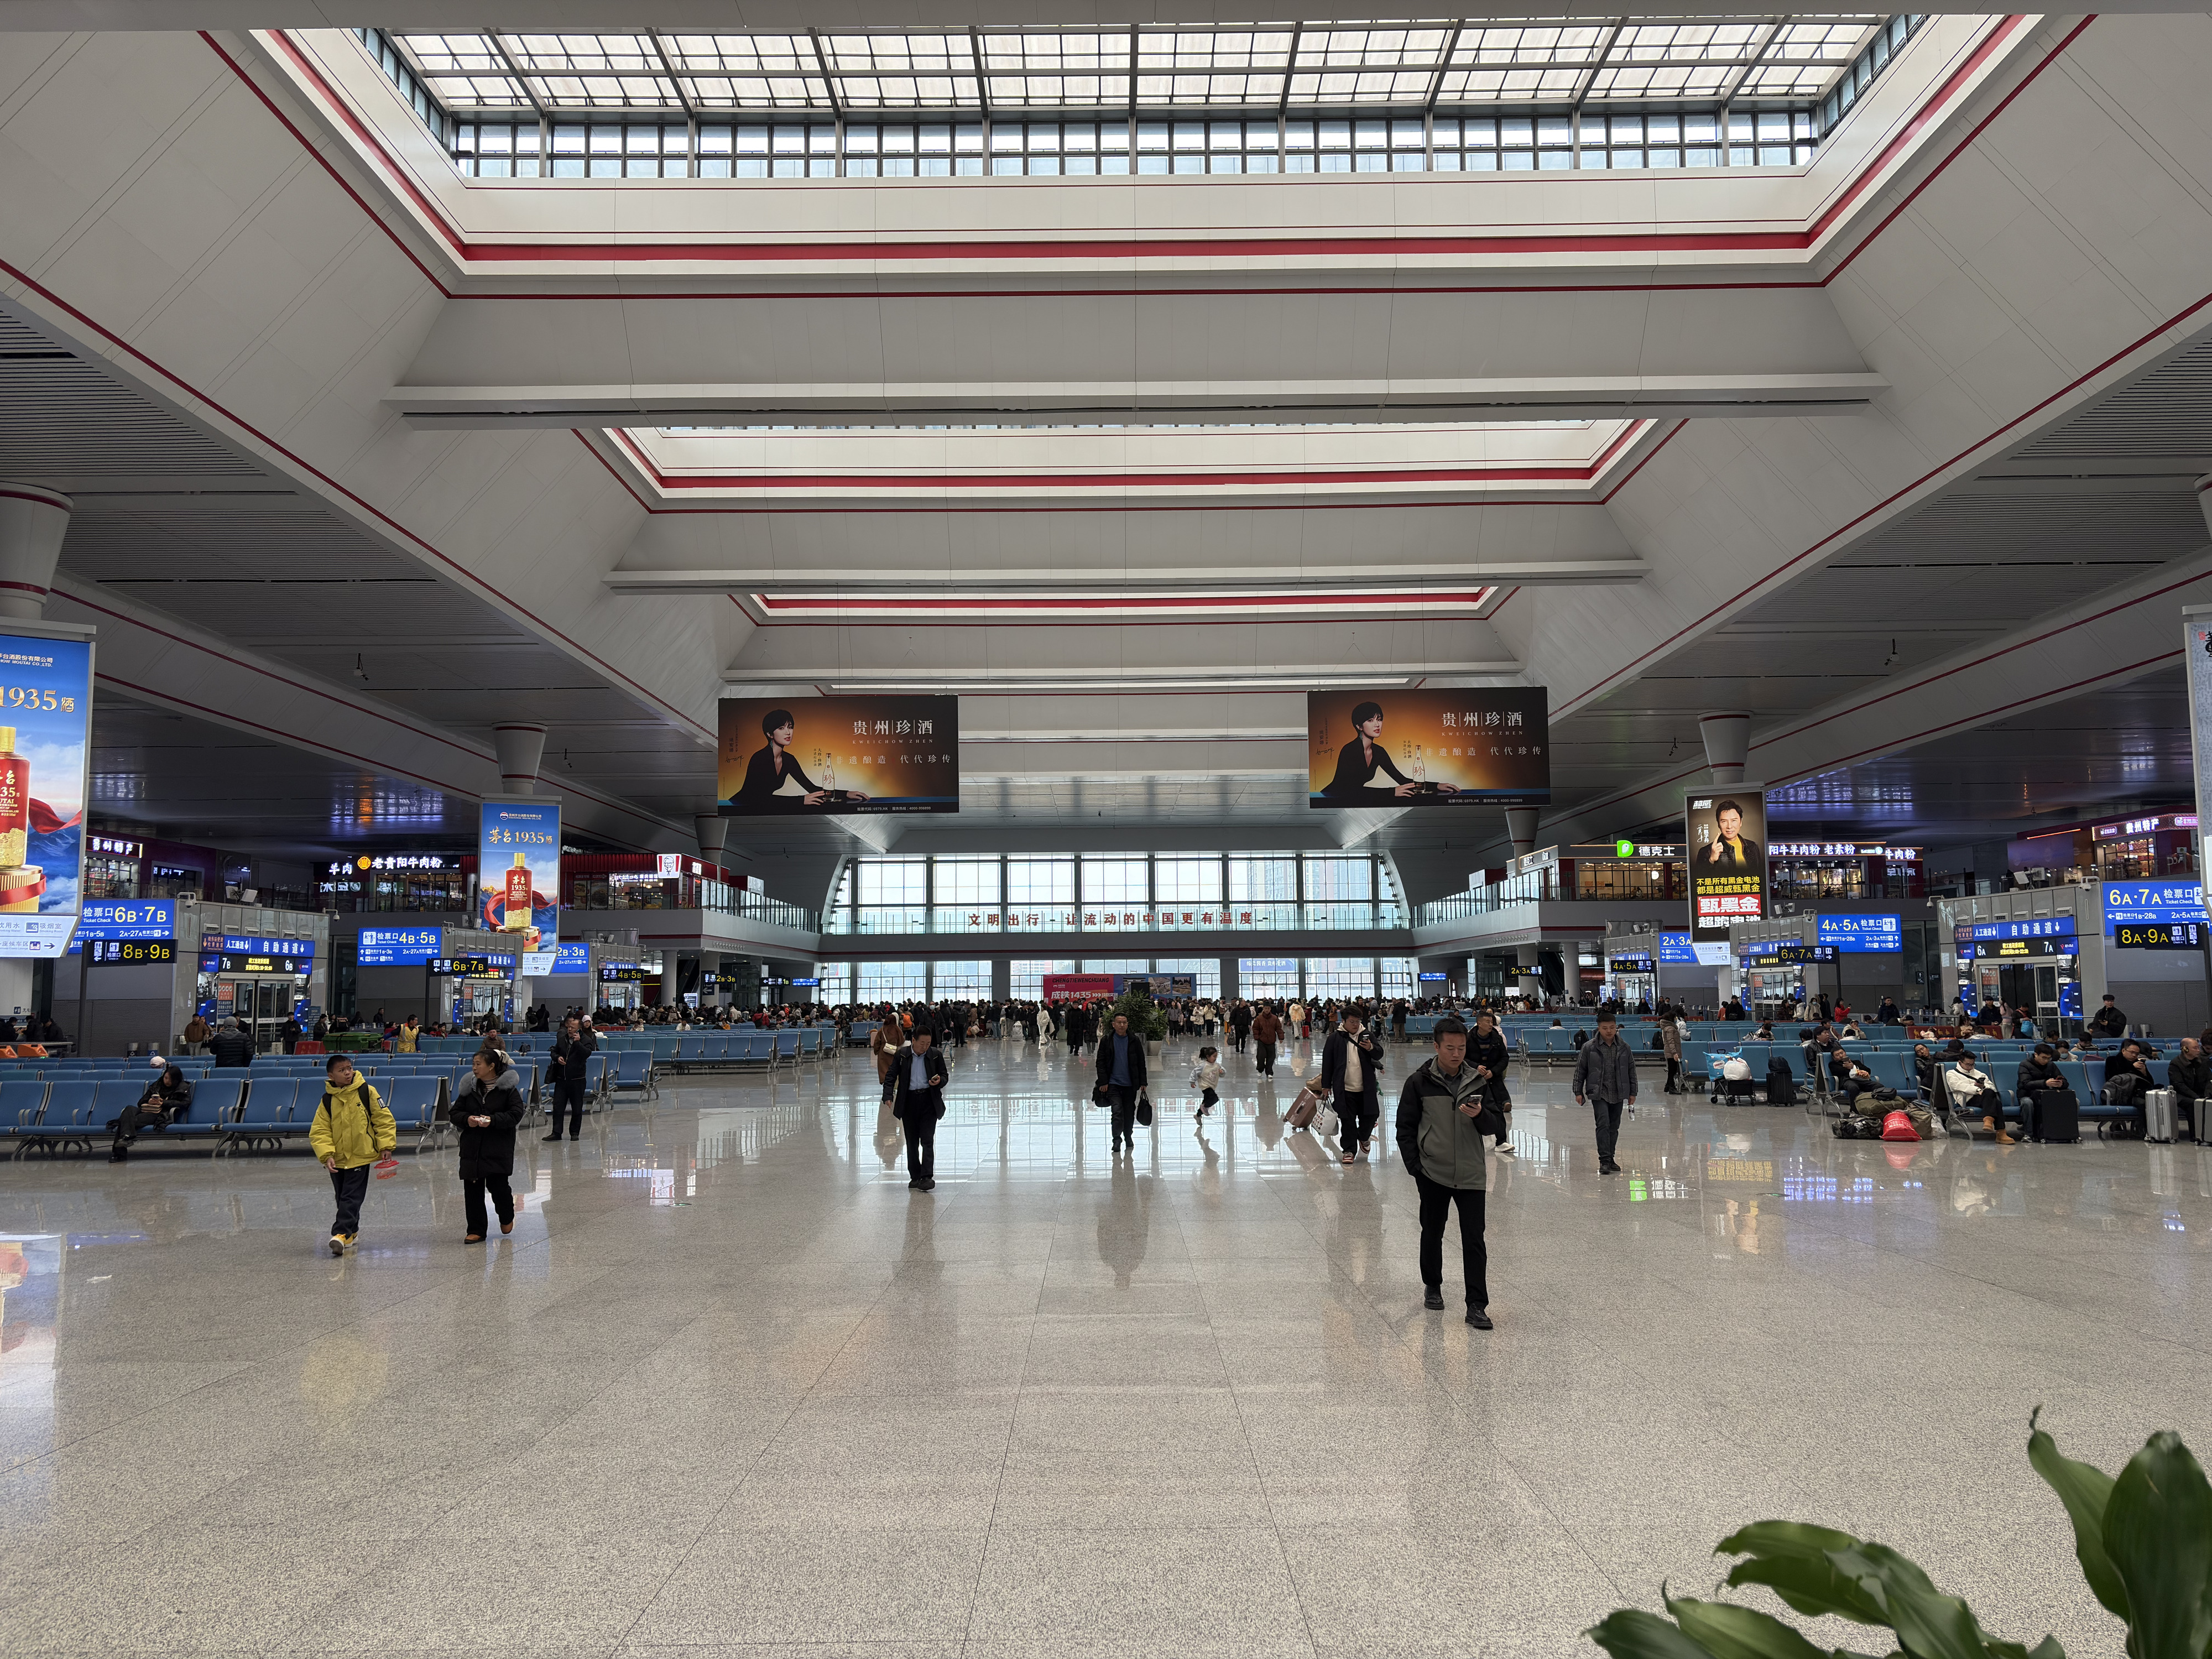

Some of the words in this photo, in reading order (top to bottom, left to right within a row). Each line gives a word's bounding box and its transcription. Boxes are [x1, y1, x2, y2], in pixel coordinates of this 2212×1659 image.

[1441, 711, 1522, 727] 贵州珍酒
[852, 719, 933, 735] 贵州珍酒
[1425, 747, 1476, 757] 非遗酿造
[836, 755, 886, 764] 非遗酿造
[1639, 846, 1675, 857] 德克士
[1824, 844, 1855, 855] 老素粉
[372, 857, 442, 869] 老贵阳牛肉粉
[328, 863, 353, 875] 羊肉
[512, 874, 525, 884] 茅台
[1696, 876, 1760, 886] 不是所有黑金电池
[1697, 884, 1760, 895] 都是超威甄黑金
[2164, 889, 2193, 899] 检票口
[83, 907, 113, 917] 检票口
[968, 912, 1040, 926] 文明出行
[1065, 912, 1253, 926] 让流动的中国更有温度
[1975, 928, 1992, 937] 人工通道
[2012, 921, 2052, 936] 自助通道
[226, 940, 244, 950] 人工通道
[263, 940, 299, 954] 自助通道
[1977, 945, 1986, 956] 6A
[2043, 941, 2053, 953] 7A
[222, 958, 231, 969] 7B
[285, 959, 293, 971] 6B
[1051, 991, 1092, 999] 成铁1435
